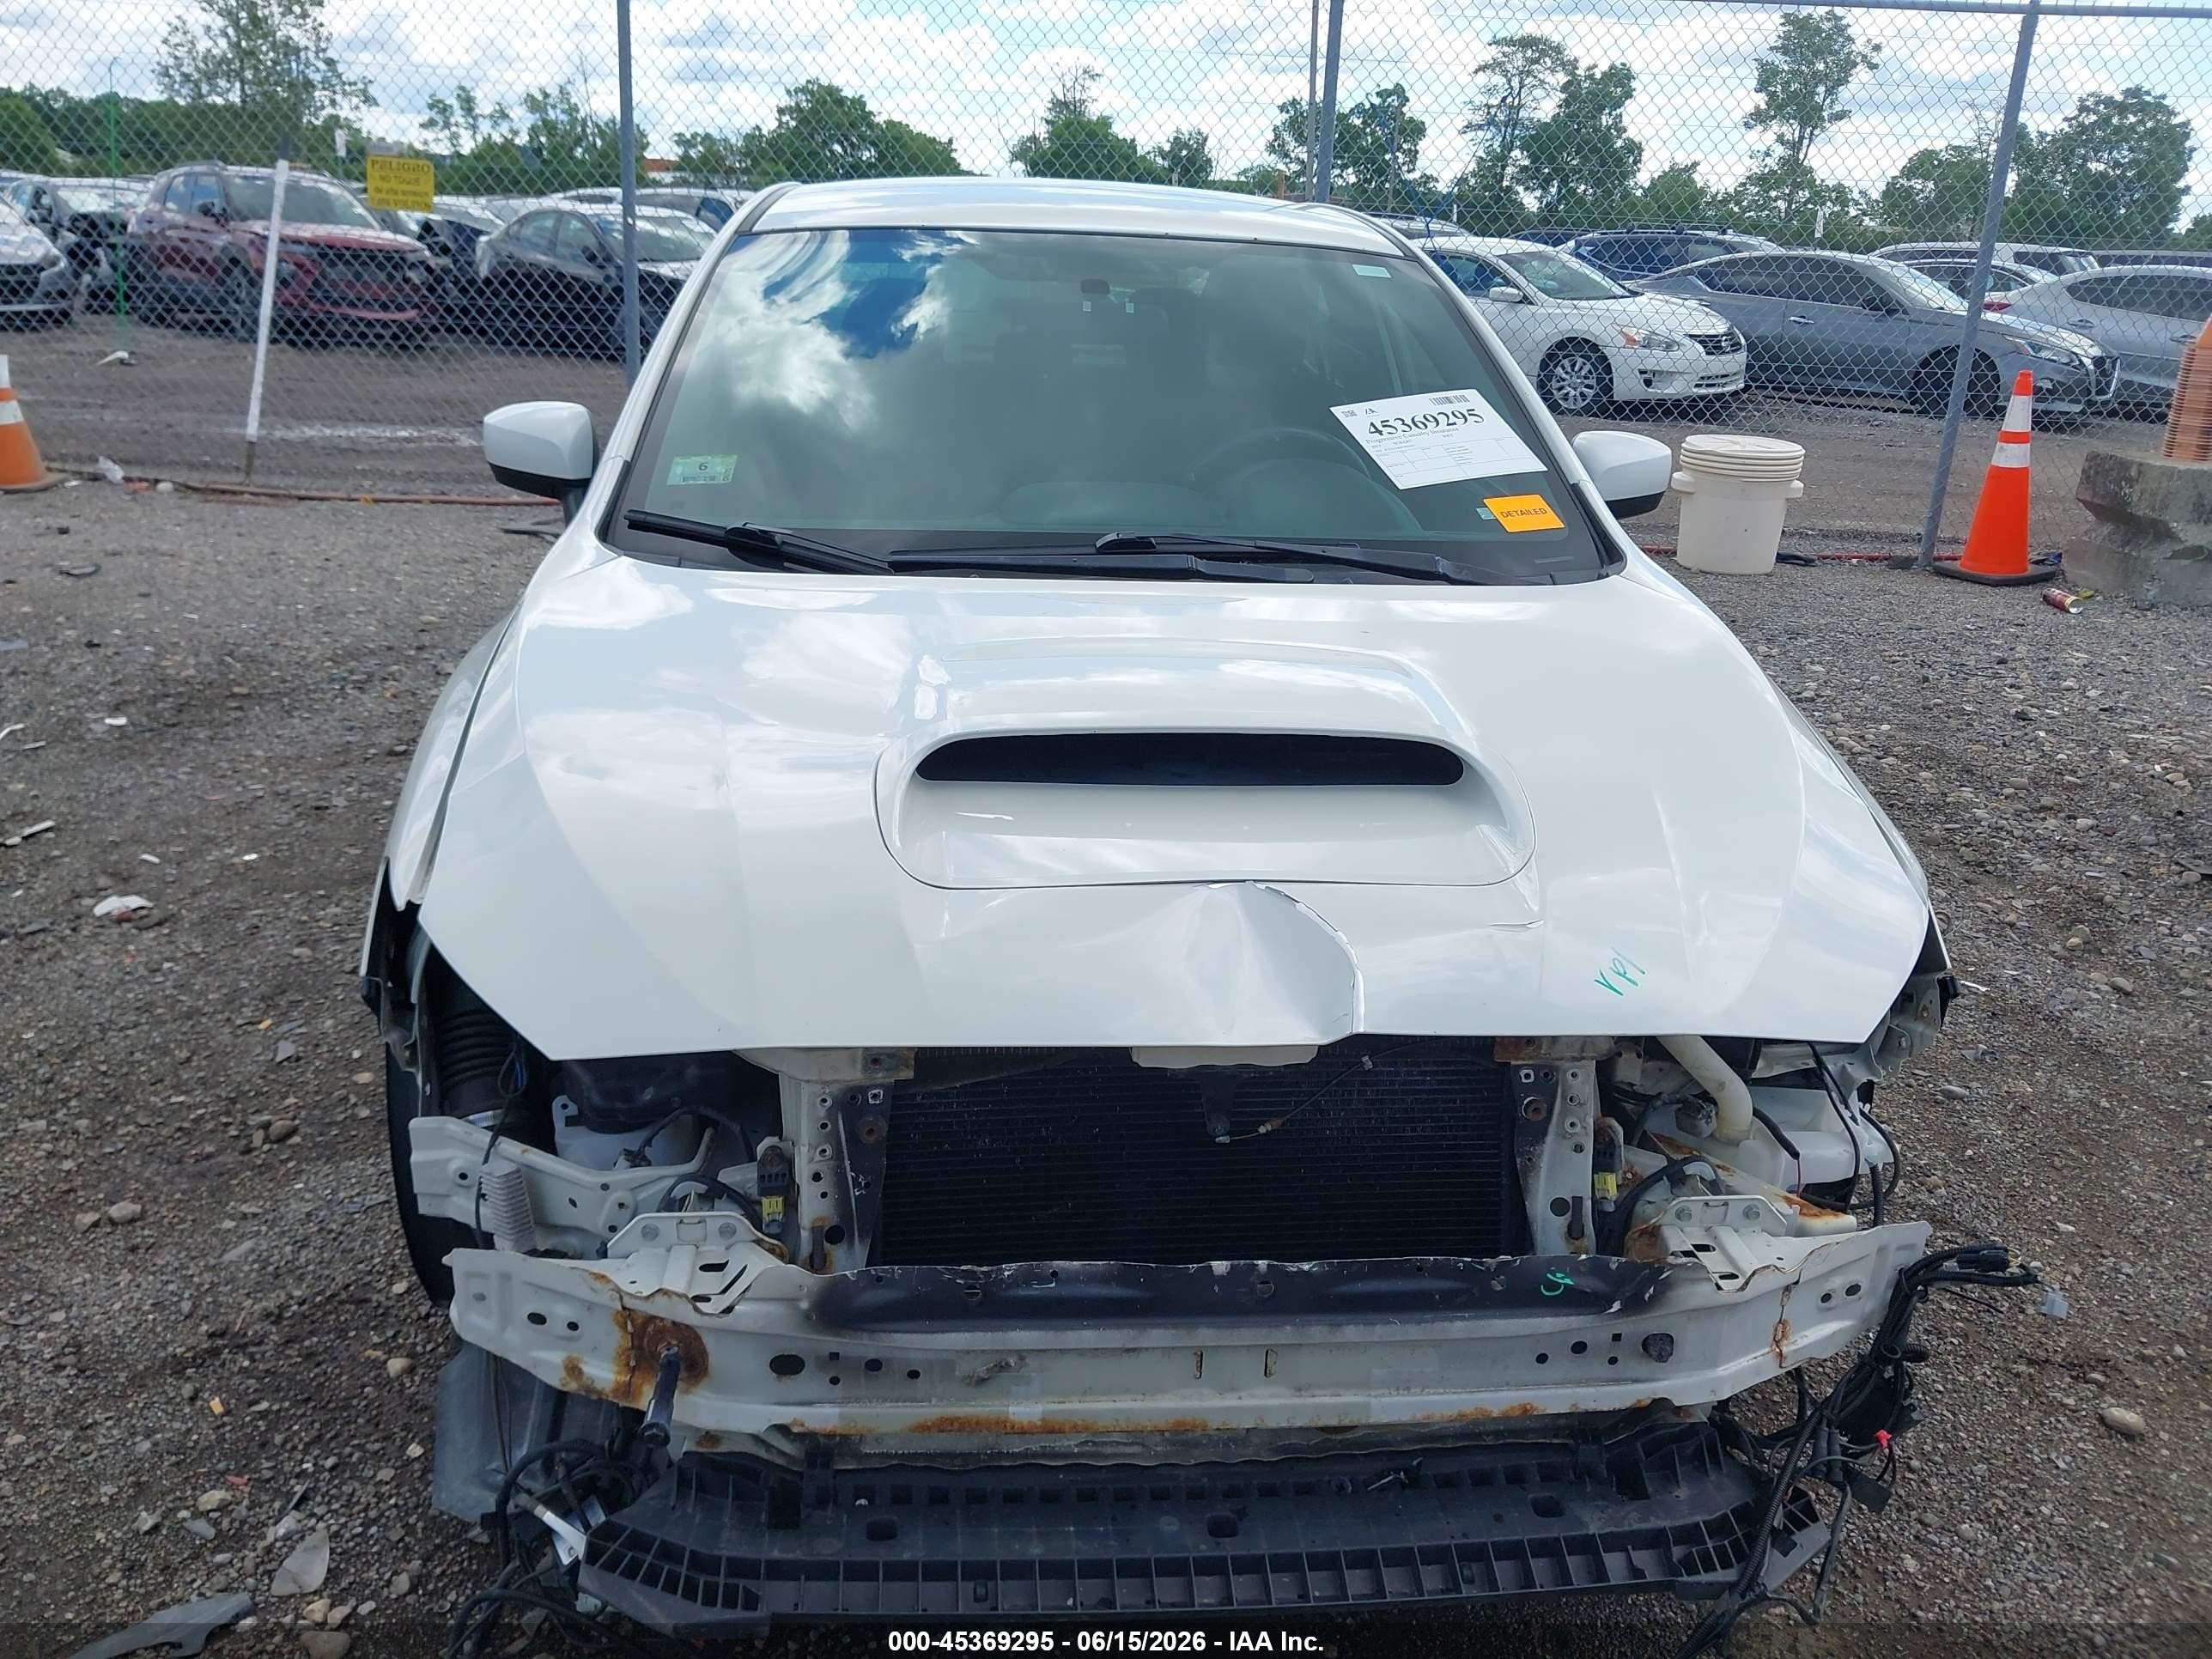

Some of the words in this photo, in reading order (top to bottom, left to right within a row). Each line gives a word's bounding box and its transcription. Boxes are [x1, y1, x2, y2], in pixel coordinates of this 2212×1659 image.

[1368, 408, 1485, 436] 45369295
[1366, 434, 1401, 445] Progressive
[698, 462, 708, 471] 6
[1500, 507, 1547, 519] DETAILED
